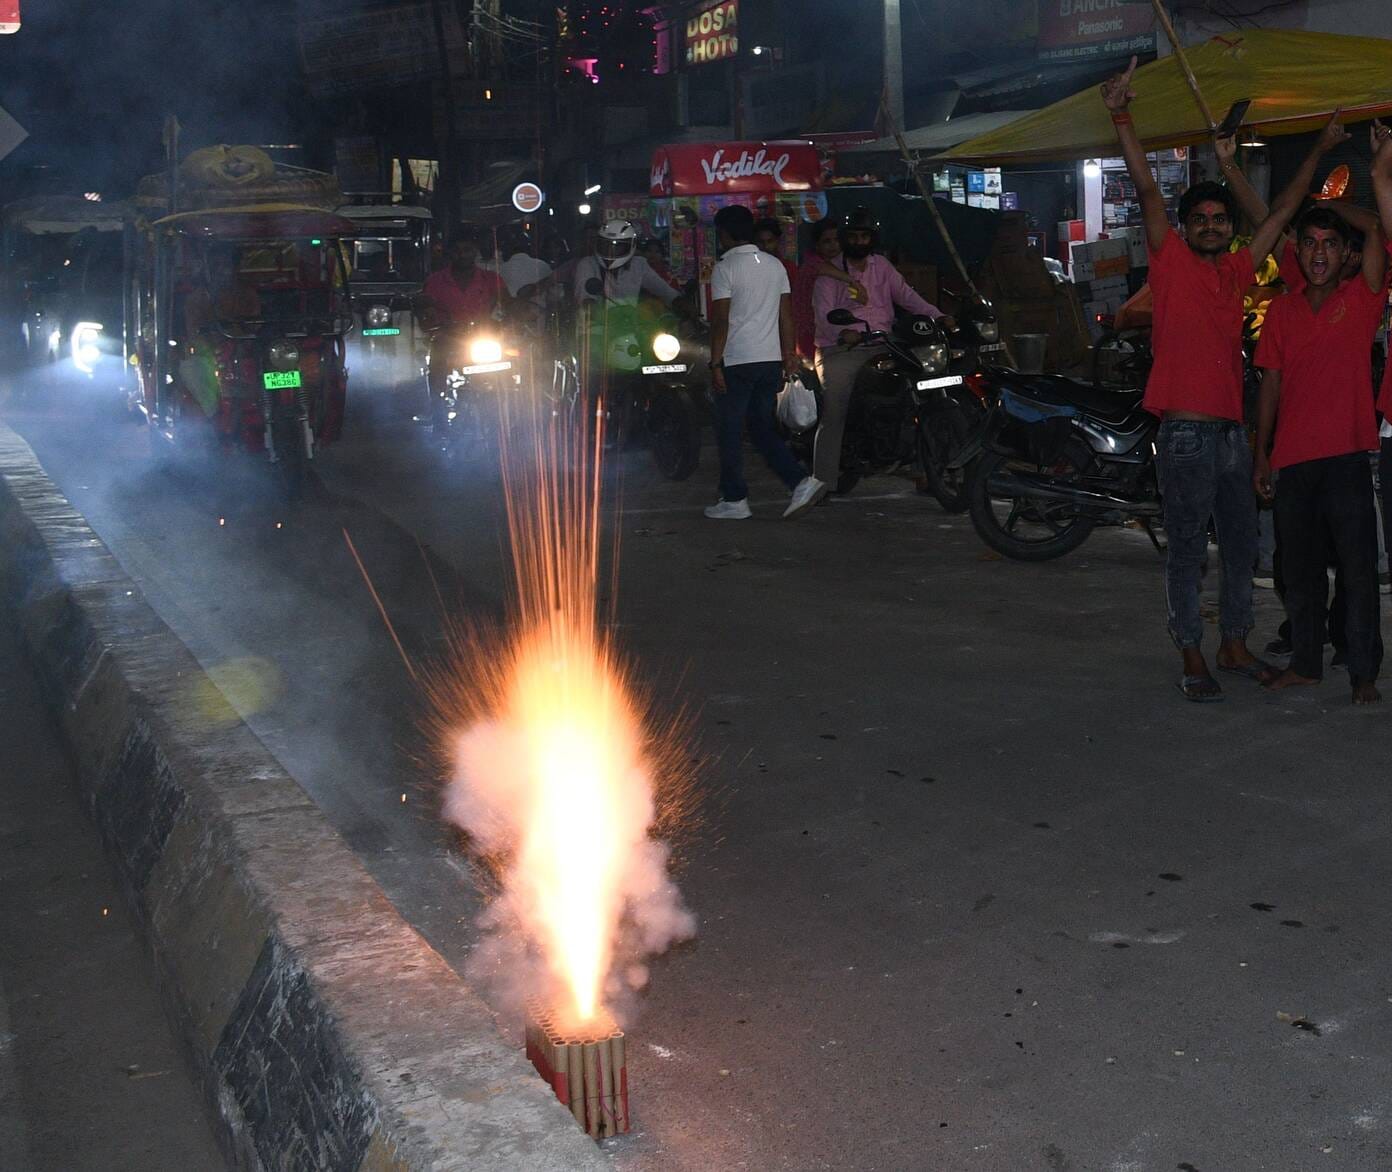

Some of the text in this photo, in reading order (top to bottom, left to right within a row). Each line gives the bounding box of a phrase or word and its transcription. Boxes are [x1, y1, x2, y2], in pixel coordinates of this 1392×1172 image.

[687, 4, 737, 37] DOSA
[1078, 17, 1124, 35] Panasonic
[701, 149, 790, 188] Vadilal
